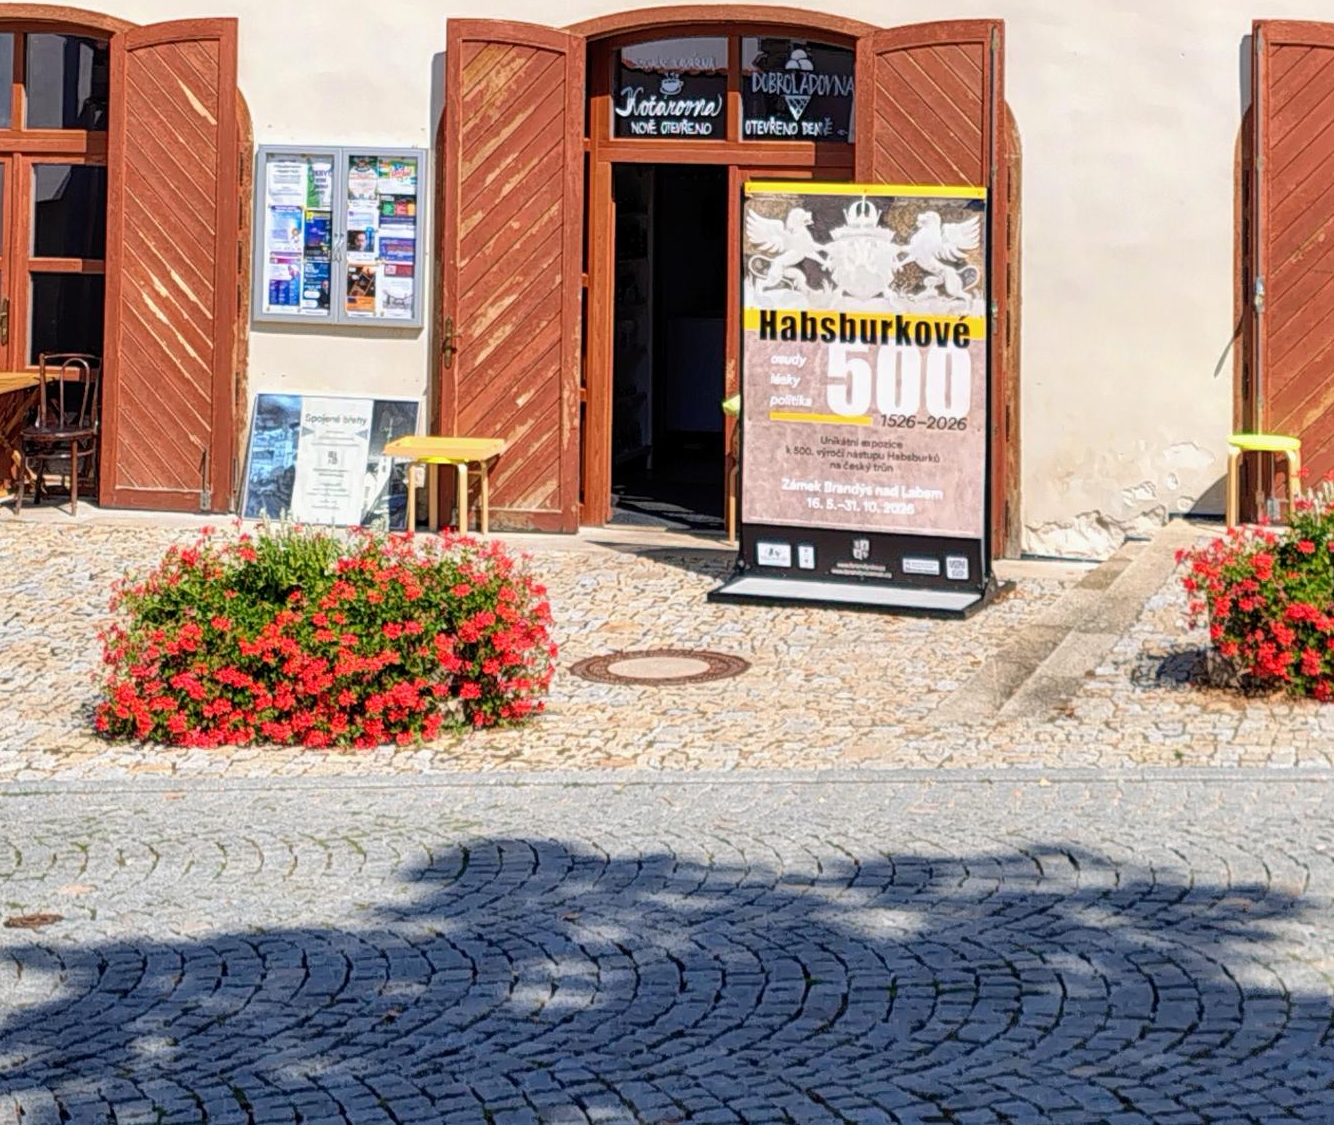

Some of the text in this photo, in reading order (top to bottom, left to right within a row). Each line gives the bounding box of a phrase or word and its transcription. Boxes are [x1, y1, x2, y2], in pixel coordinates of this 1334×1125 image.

[661, 119, 712, 135] OTEVŘENO
[745, 116, 799, 135] OTEVŘENO
[760, 310, 971, 348] Habsburkové
[770, 353, 807, 367] osudy
[826, 340, 972, 417] 500
[769, 394, 812, 408] politika
[305, 412, 340, 426] Spojené
[820, 435, 903, 450] Unikátní expozice
[793, 447, 814, 456] 500.
[816, 448, 845, 458] výročí
[846, 449, 885, 461] nástupu
[887, 452, 940, 464] Habsburků
[830, 461, 893, 473] na český trůn
[781, 477, 944, 500] Zámek Brandýs nad Labem
[807, 497, 823, 509] 16.
[863, 501, 880, 513] 10.
